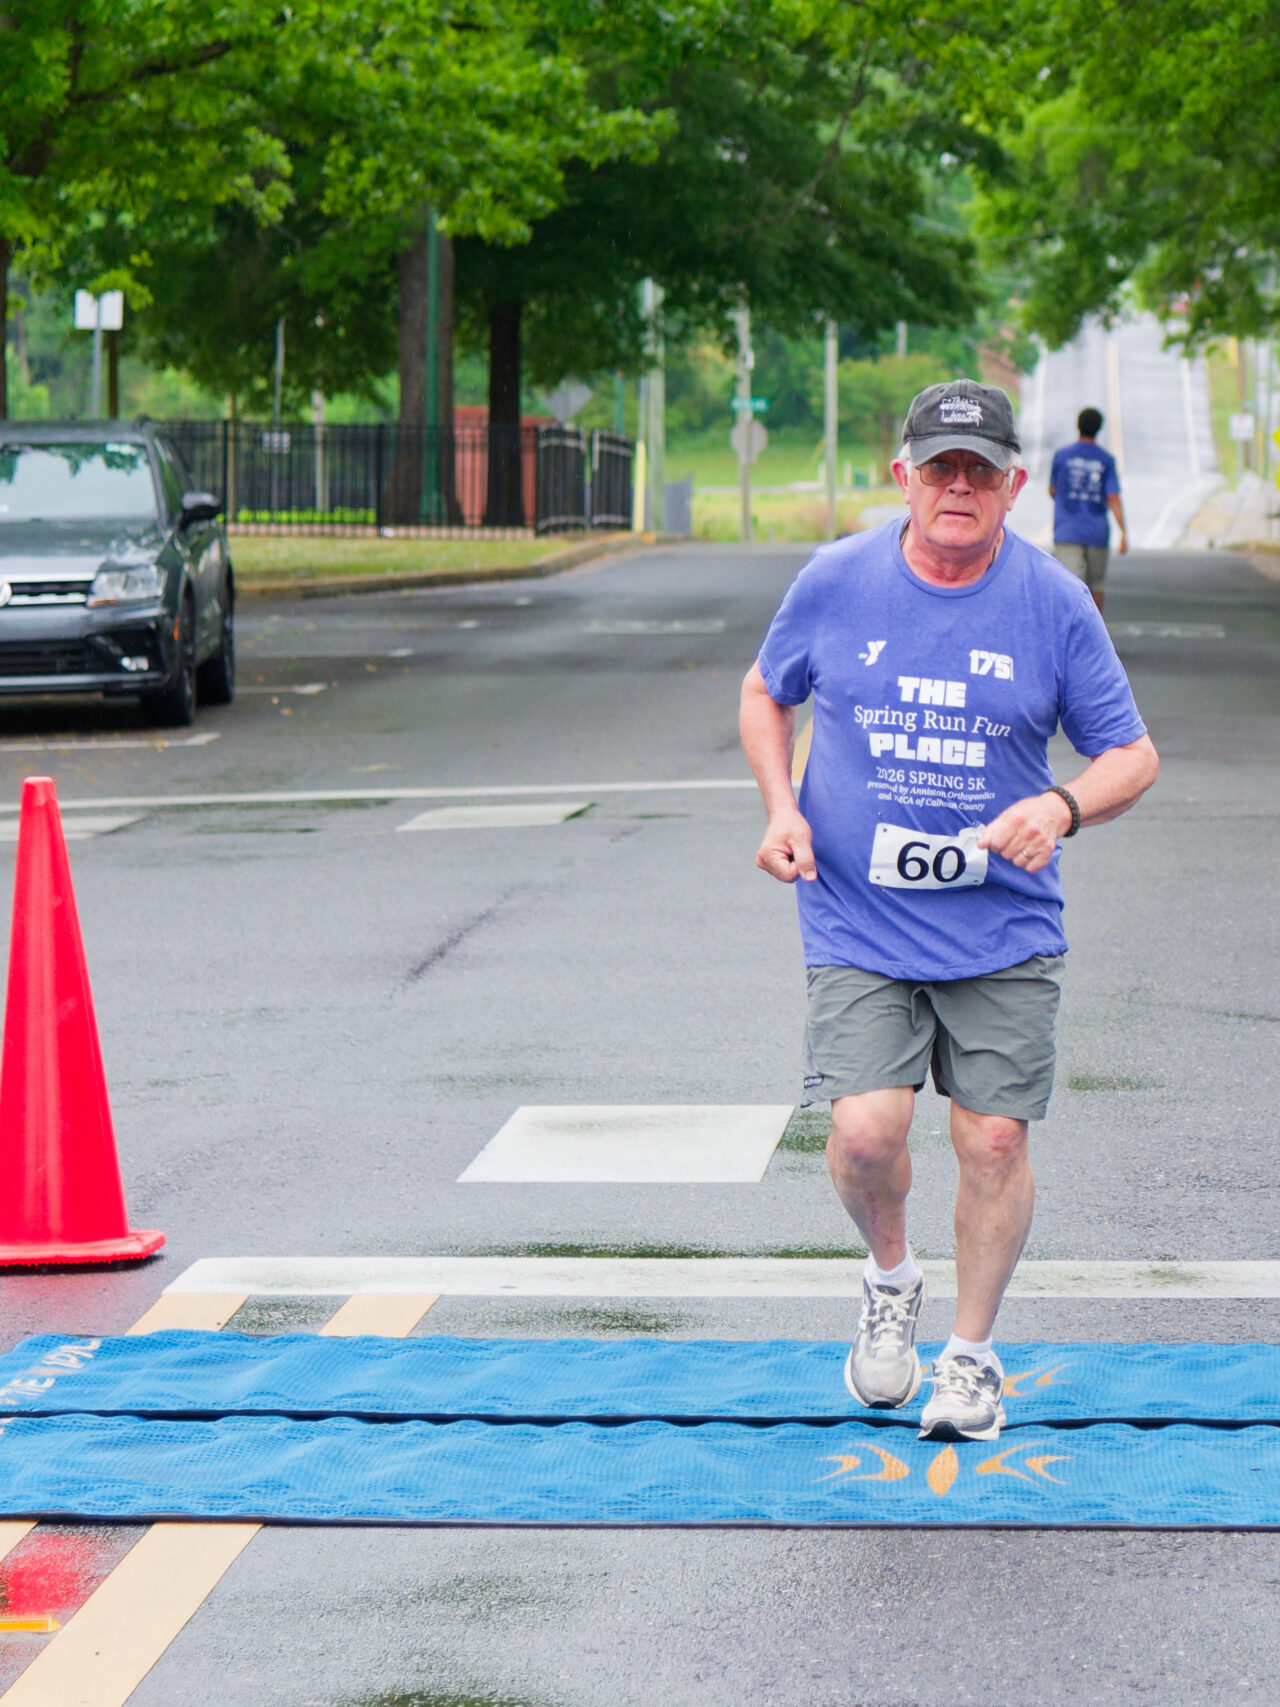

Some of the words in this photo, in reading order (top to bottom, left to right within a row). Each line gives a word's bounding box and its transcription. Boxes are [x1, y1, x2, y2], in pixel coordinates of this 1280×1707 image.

[897, 675, 967, 708] THE
[854, 705, 918, 733] Spring
[923, 709, 967, 732] Run
[971, 716, 1011, 737] Fun
[869, 732, 987, 768] PLACE
[899, 784, 909, 796] by
[910, 787, 947, 798] Anniston
[947, 790, 996, 802] Orthopaedics
[909, 770, 964, 790] SPRING
[967, 777, 986, 791] 5K
[878, 791, 892, 801] and
[915, 797, 926, 807] of
[958, 802, 986, 812] County
[897, 841, 966, 883] 60
